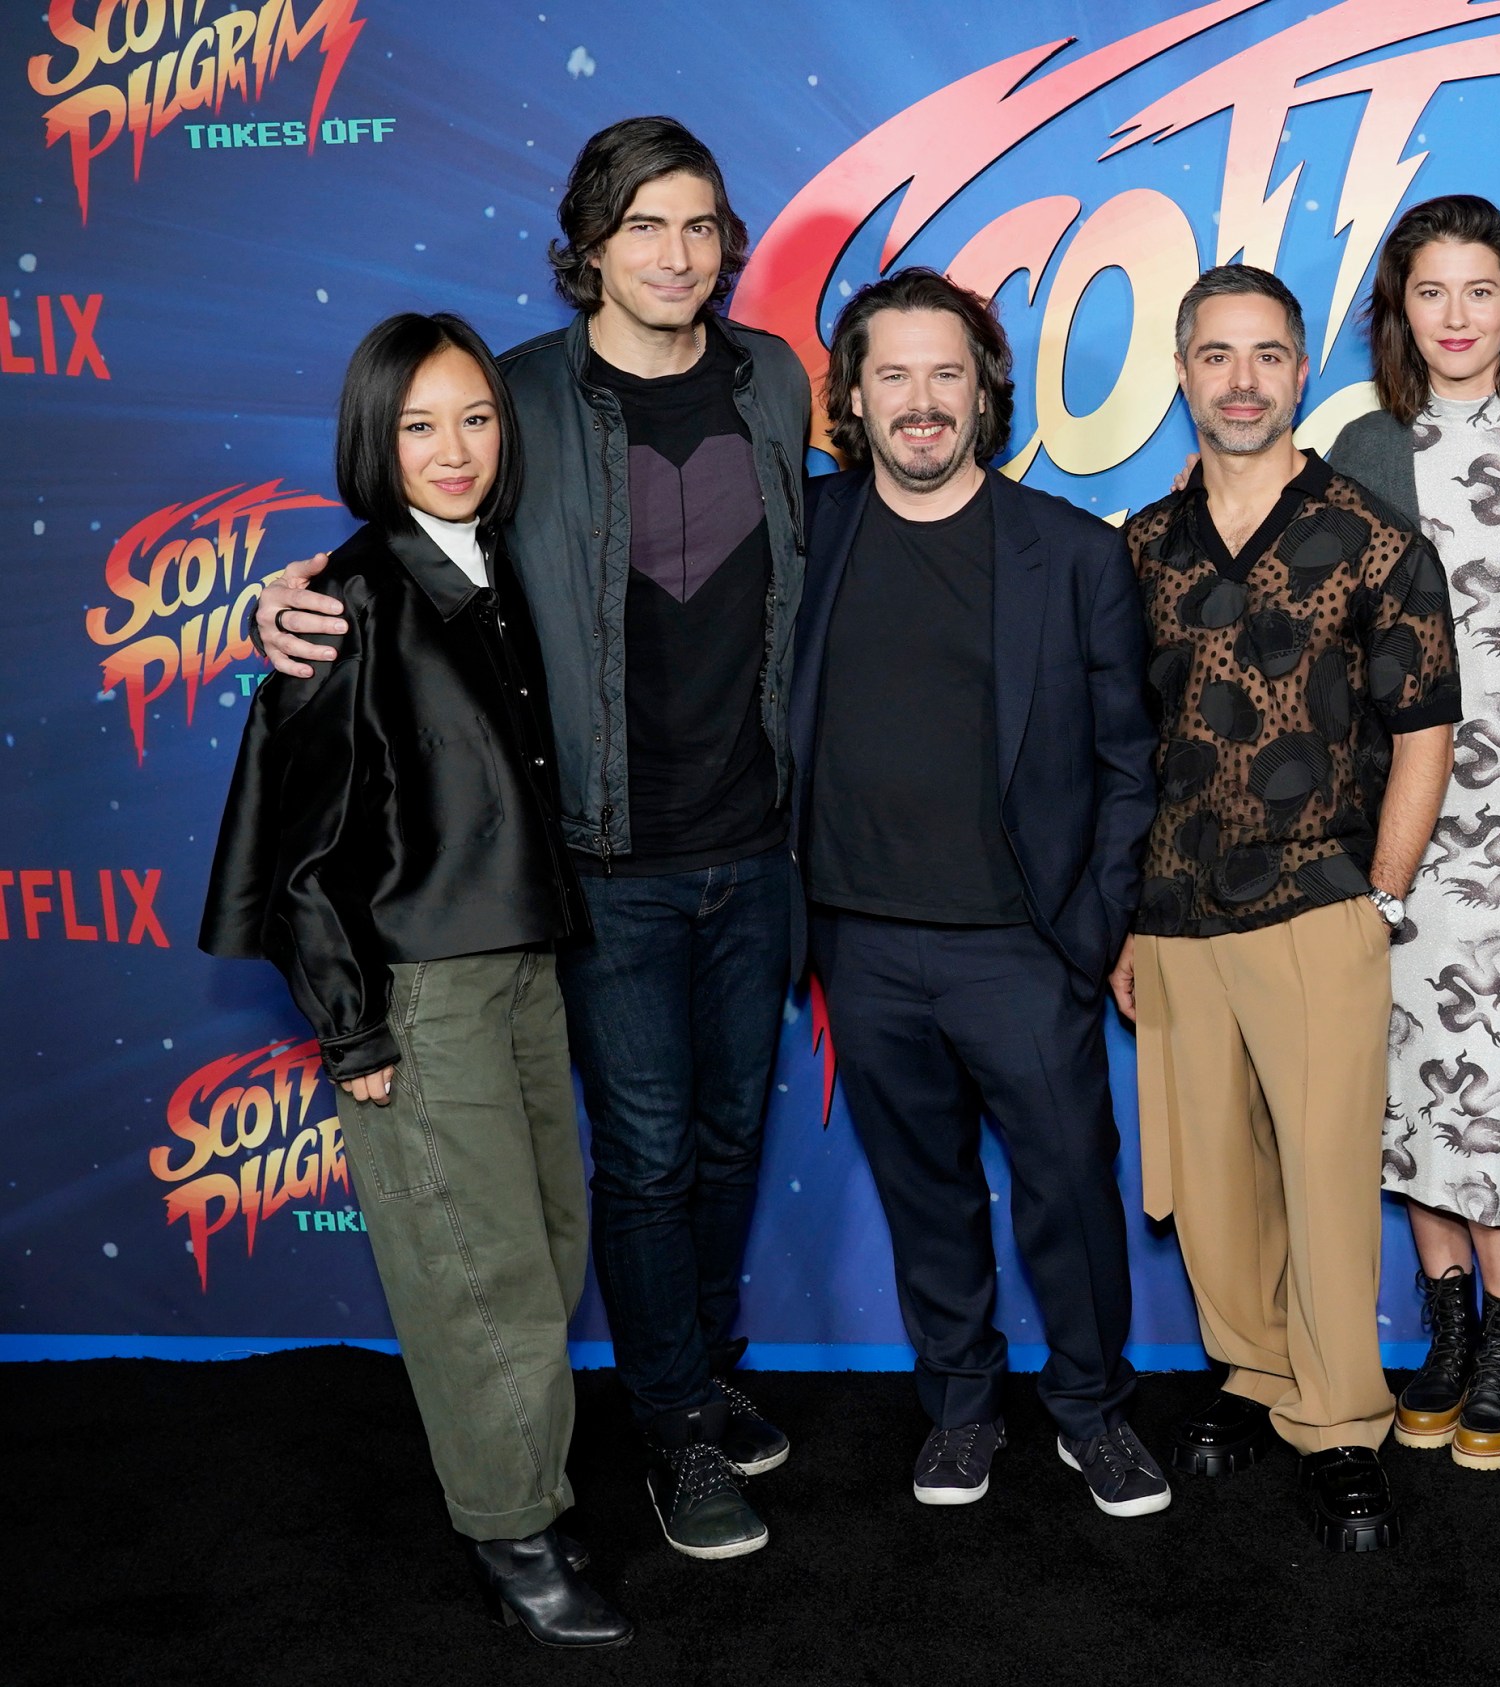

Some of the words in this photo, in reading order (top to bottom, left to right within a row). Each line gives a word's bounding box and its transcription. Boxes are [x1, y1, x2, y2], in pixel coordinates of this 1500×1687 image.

[27, 0, 206, 96] SCO
[42, 0, 368, 229] PILGRIM
[184, 121, 306, 149] TAKES
[321, 118, 396, 145] OFF
[86, 478, 346, 646] SCOTT
[149, 1037, 324, 1182] SCOTT
[162, 1116, 350, 1295] PILGR
[292, 1210, 369, 1232] TAK
